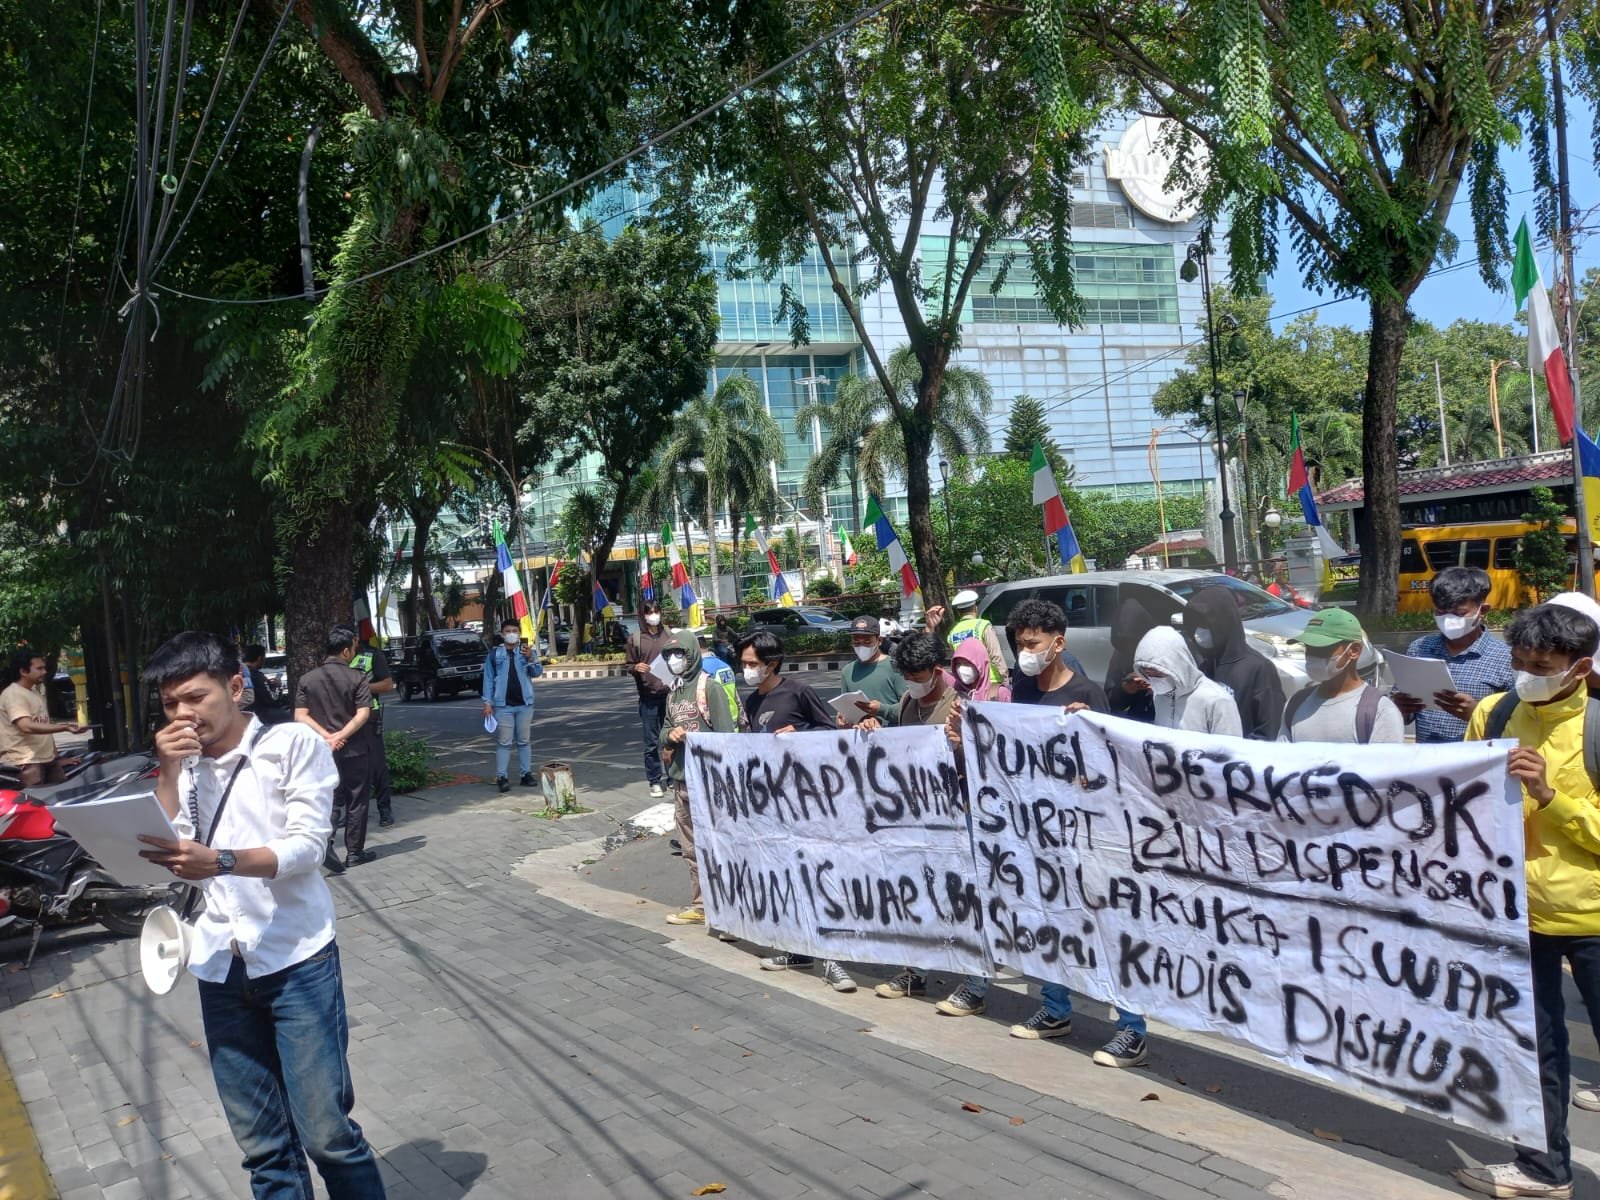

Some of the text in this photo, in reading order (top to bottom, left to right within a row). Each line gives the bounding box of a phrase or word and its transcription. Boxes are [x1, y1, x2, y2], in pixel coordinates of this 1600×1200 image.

[690, 743, 846, 829] TANGKAP
[977, 784, 1106, 851] SURAT
[1143, 738, 1495, 861] BERKEDOK
[702, 847, 802, 928] HUKUM
[978, 840, 1024, 897] YG
[1307, 914, 1535, 1051] ISWAR
[1281, 982, 1507, 1124] DISHUB
